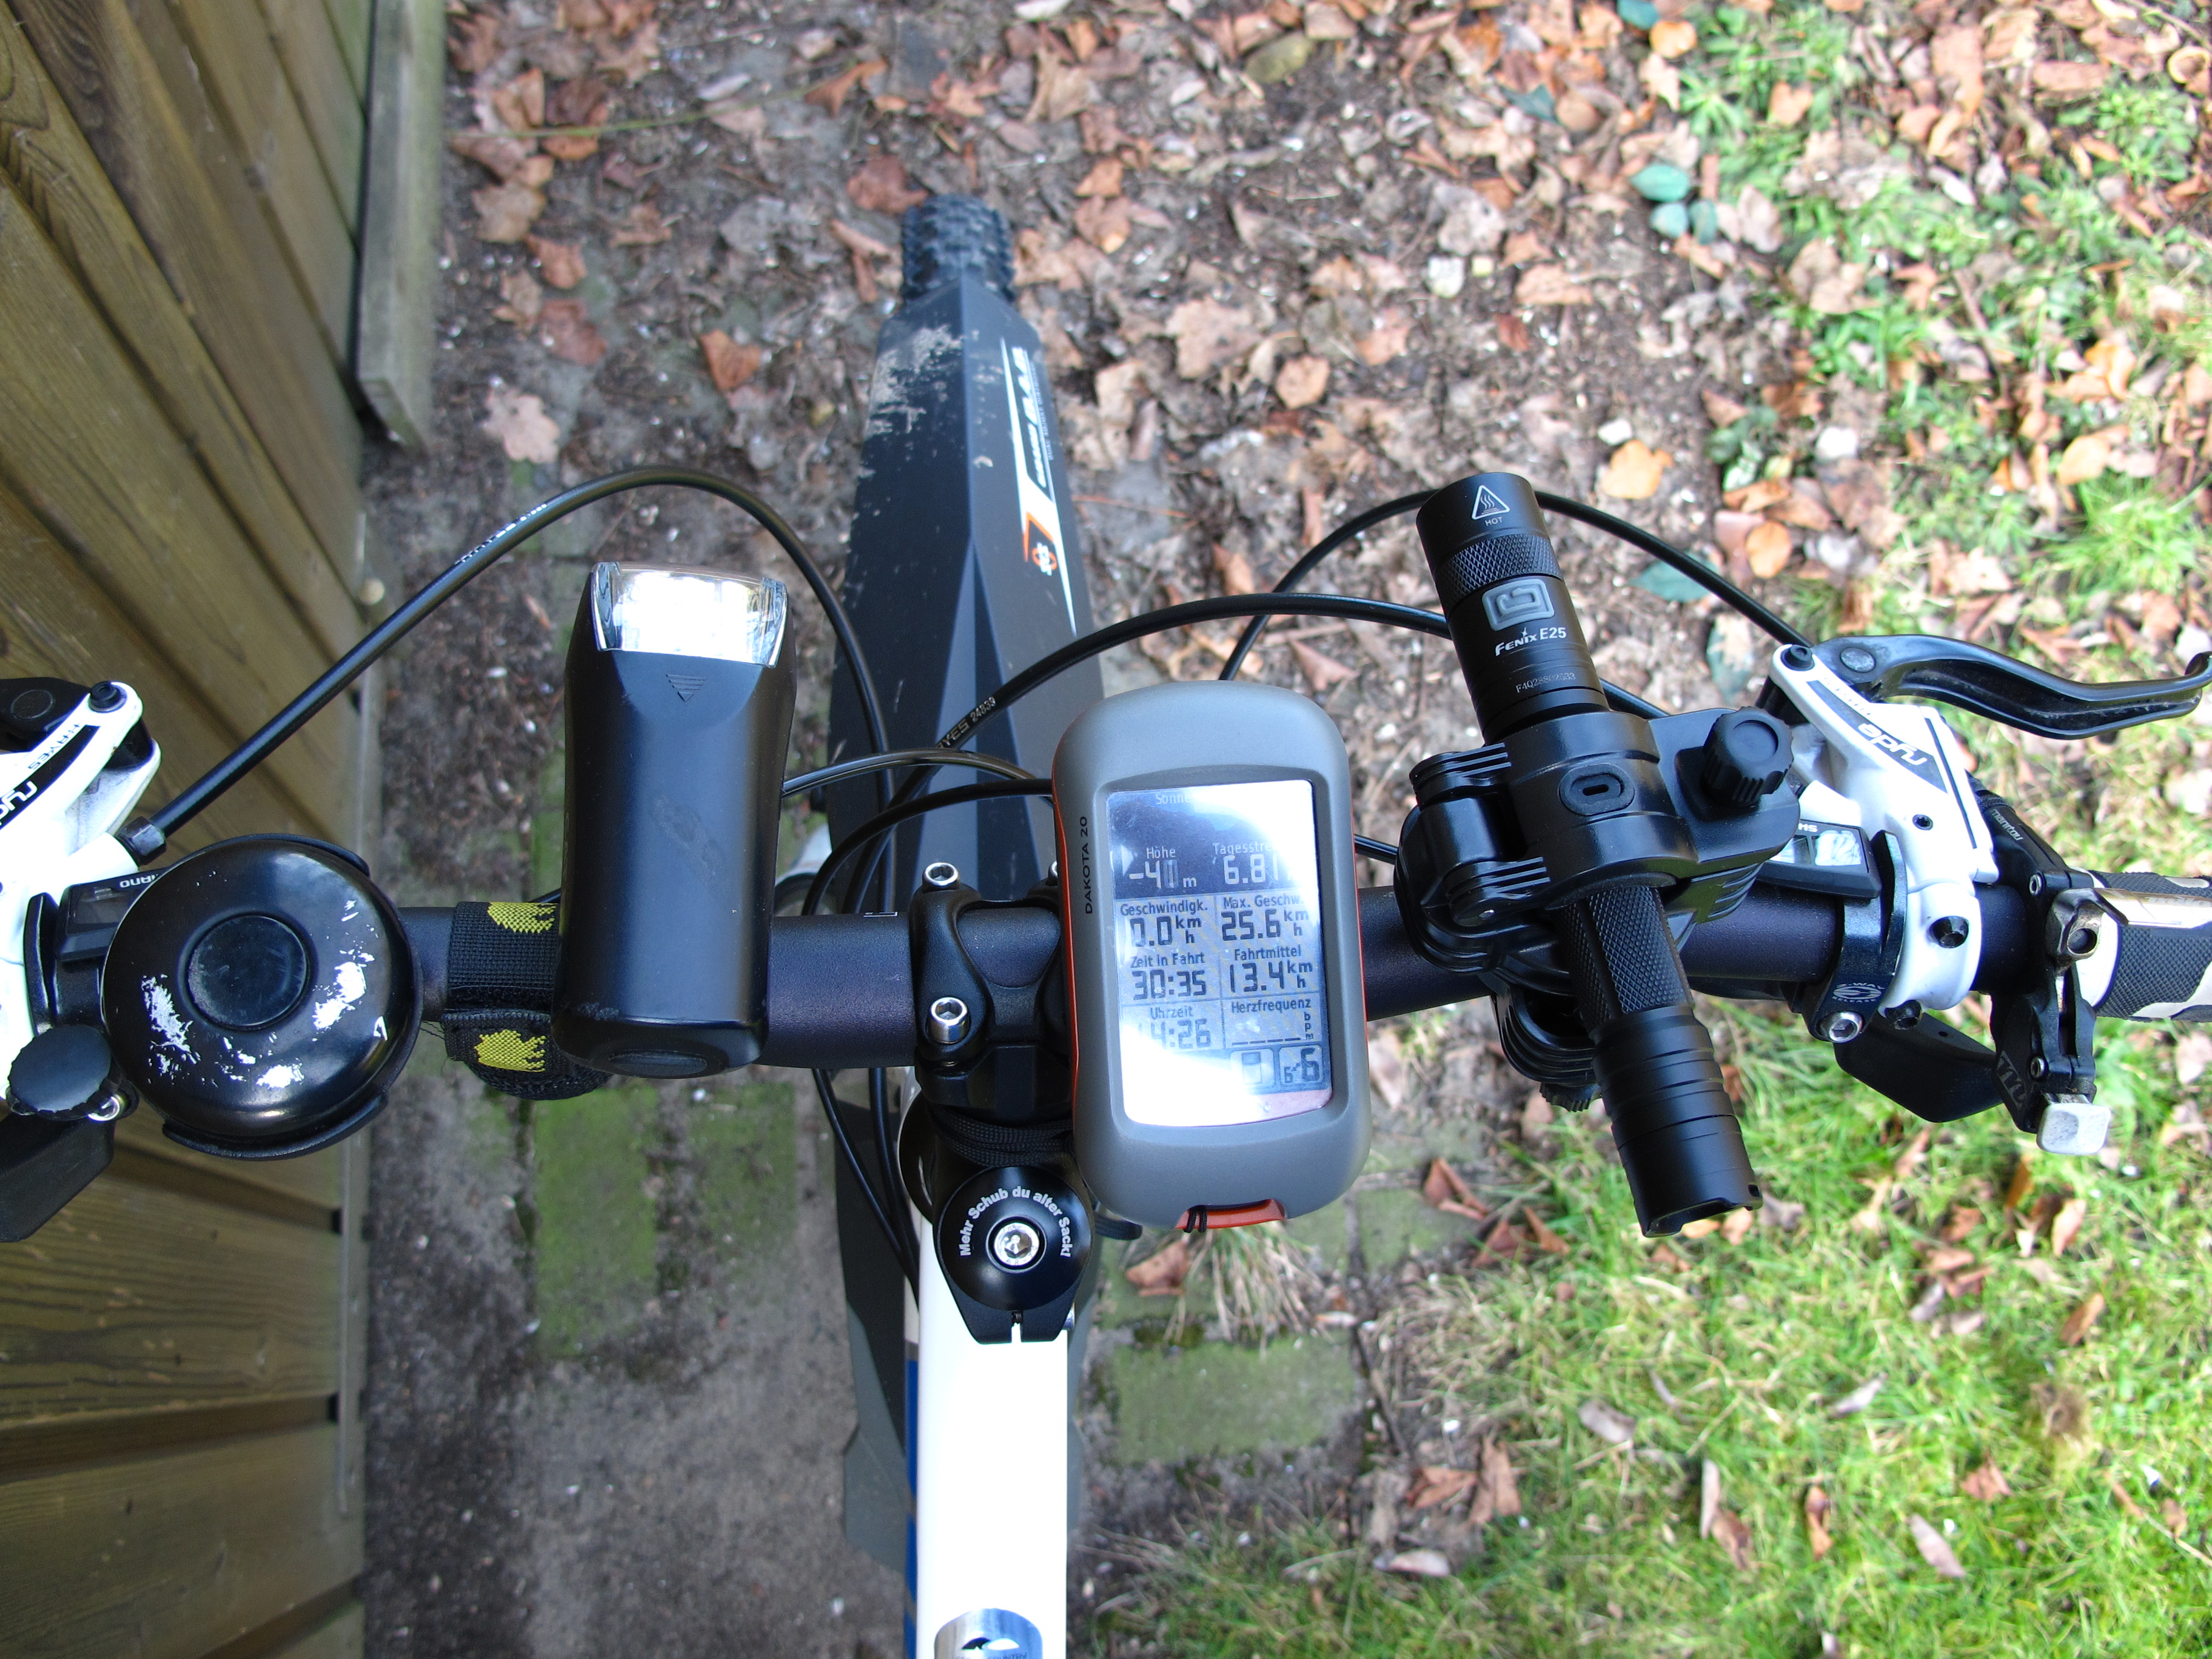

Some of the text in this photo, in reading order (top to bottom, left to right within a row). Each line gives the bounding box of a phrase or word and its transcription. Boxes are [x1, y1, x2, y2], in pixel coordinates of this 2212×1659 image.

[1485, 517, 1503, 526] HOT
[1540, 627, 1567, 640] E25
[1858, 723, 1928, 766] ryde
[1146, 846, 1176, 859] Höhe
[1080, 816, 1093, 914] DAKOTA 20
[1224, 850, 1278, 885] 6.81
[1182, 877, 1197, 888] m
[1121, 900, 1208, 916] Geschwindigk.
[1223, 894, 1304, 910] Max. Geschw.
[1130, 916, 1173, 947] 0.0
[1221, 909, 1281, 942] 25.6
[1130, 955, 1153, 969] Zeit
[1172, 951, 1206, 966] Fahrt
[1233, 944, 1302, 961] Fahrtmittel
[1131, 968, 1207, 1000] 30:35
[1229, 960, 1284, 993] 13.4
[1150, 1005, 1194, 1019] Uhrzeit
[1231, 998, 1312, 1014] Herzfrequenz
[958, 1219, 974, 1256] Mehr
[968, 1187, 1009, 1219] Schub
[1012, 1185, 1031, 1199] du
[1032, 1192, 1063, 1216] alter
